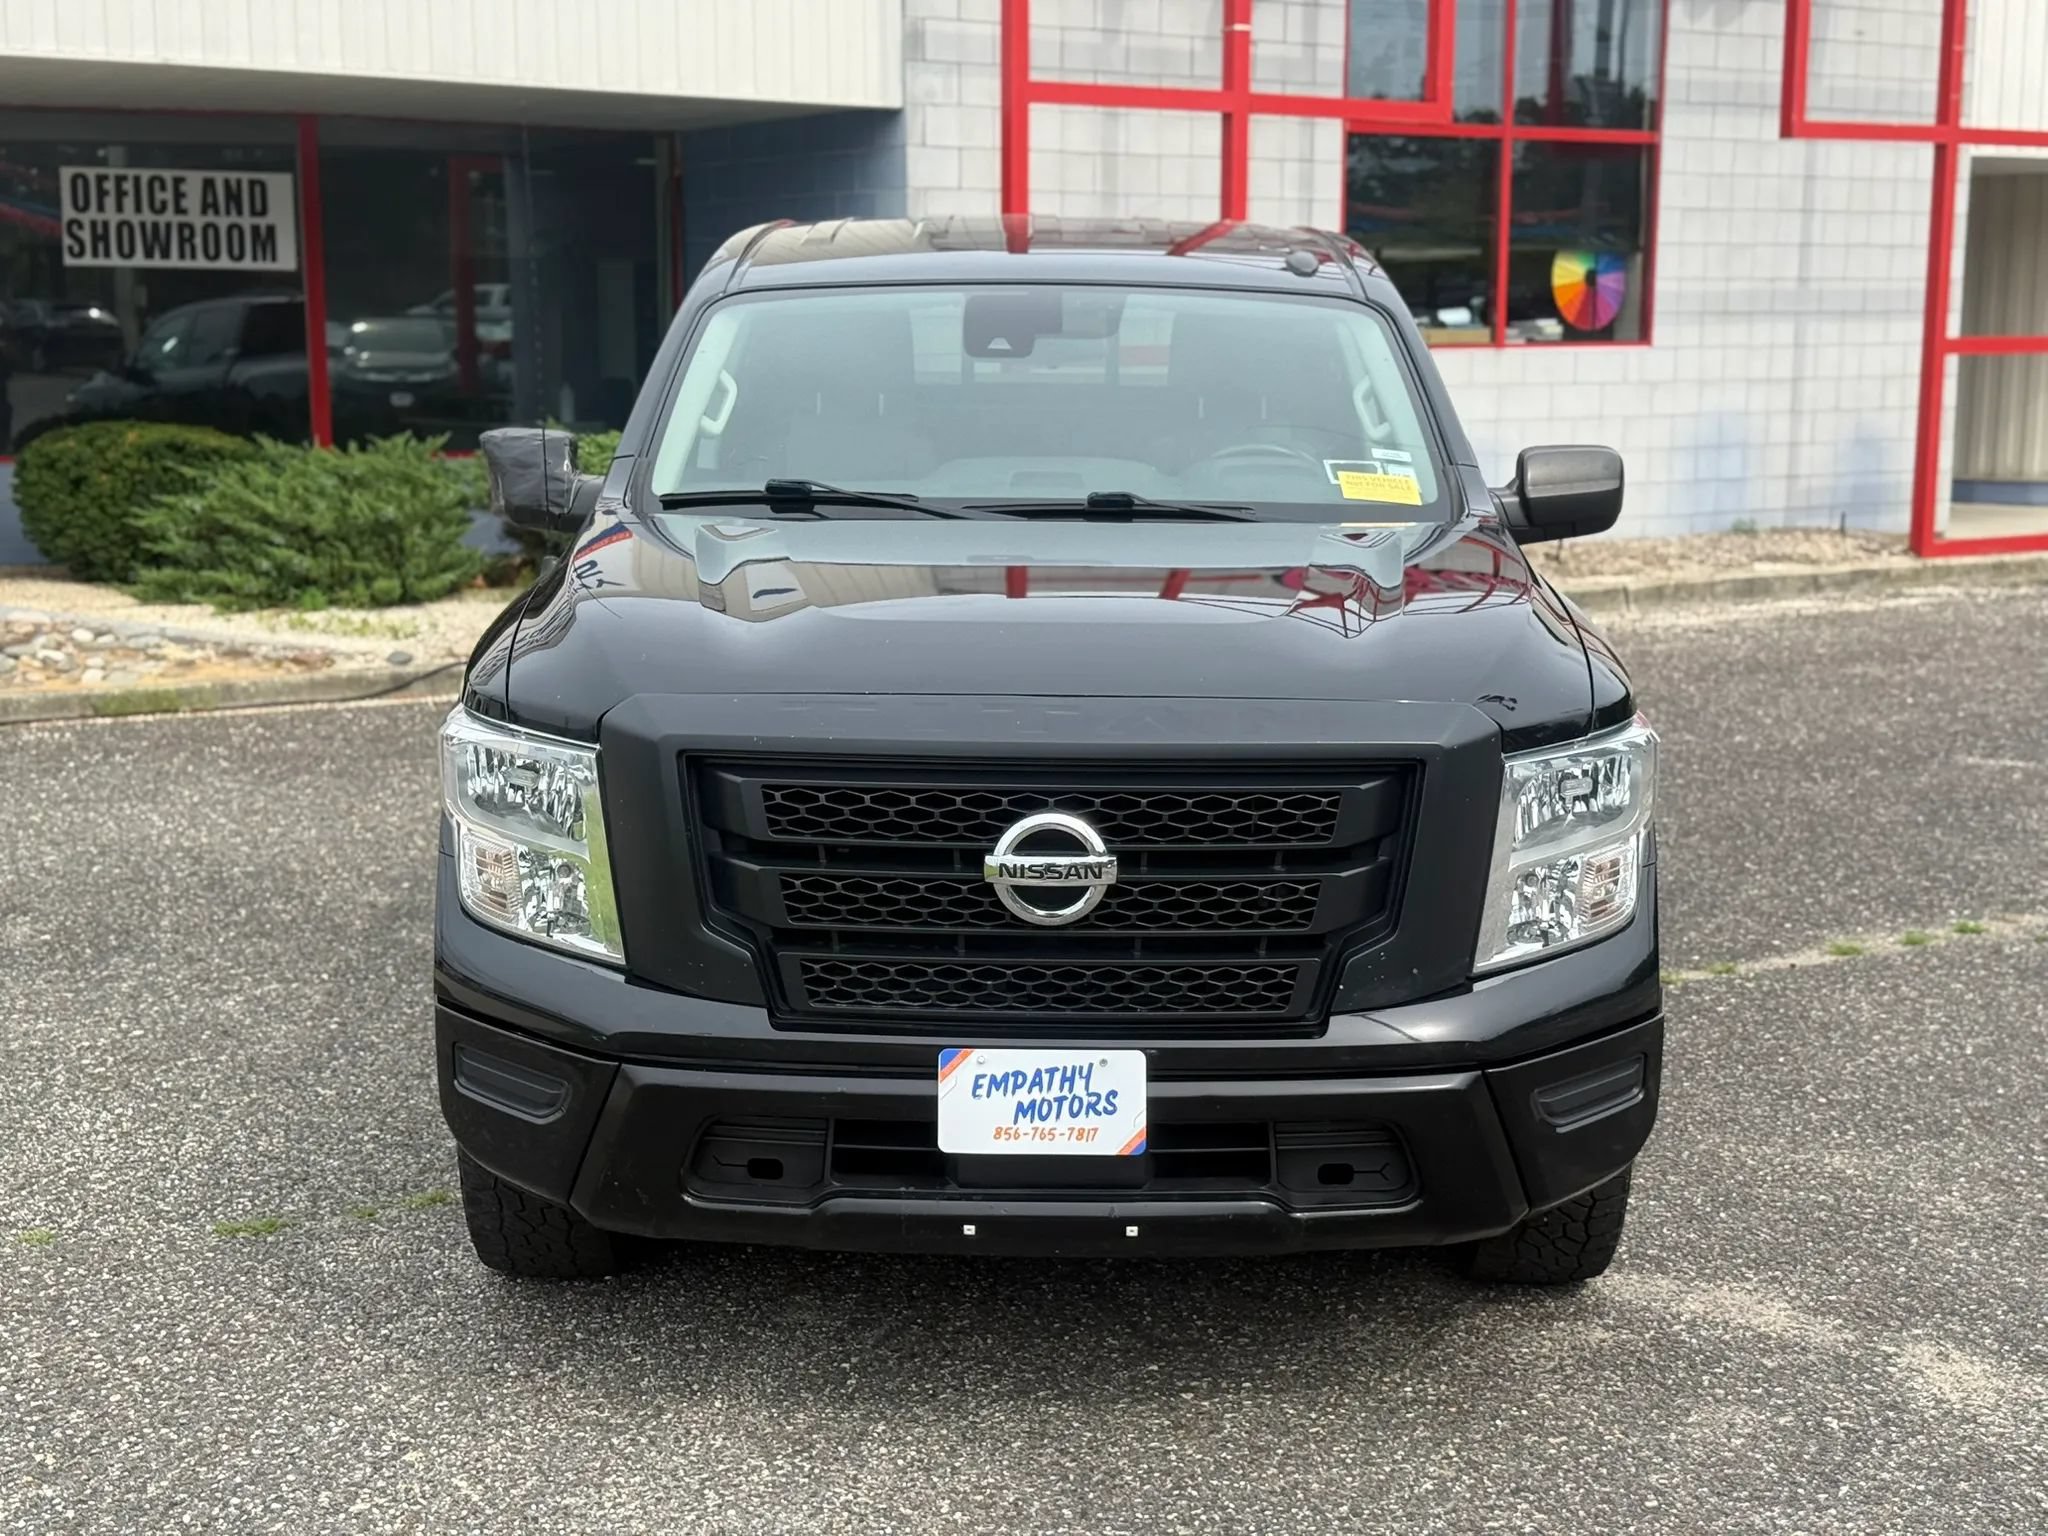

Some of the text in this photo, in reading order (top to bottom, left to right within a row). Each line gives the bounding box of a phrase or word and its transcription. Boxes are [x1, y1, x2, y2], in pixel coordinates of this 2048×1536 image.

[70, 173, 269, 218] OFFICE AND
[66, 219, 278, 263] SHOWROOM
[998, 863, 1103, 880] NISSAN
[971, 1062, 1095, 1100] EMPATHY
[1013, 1089, 1119, 1126] MOTORS
[992, 1126, 1100, 1143] 856-765-7817
